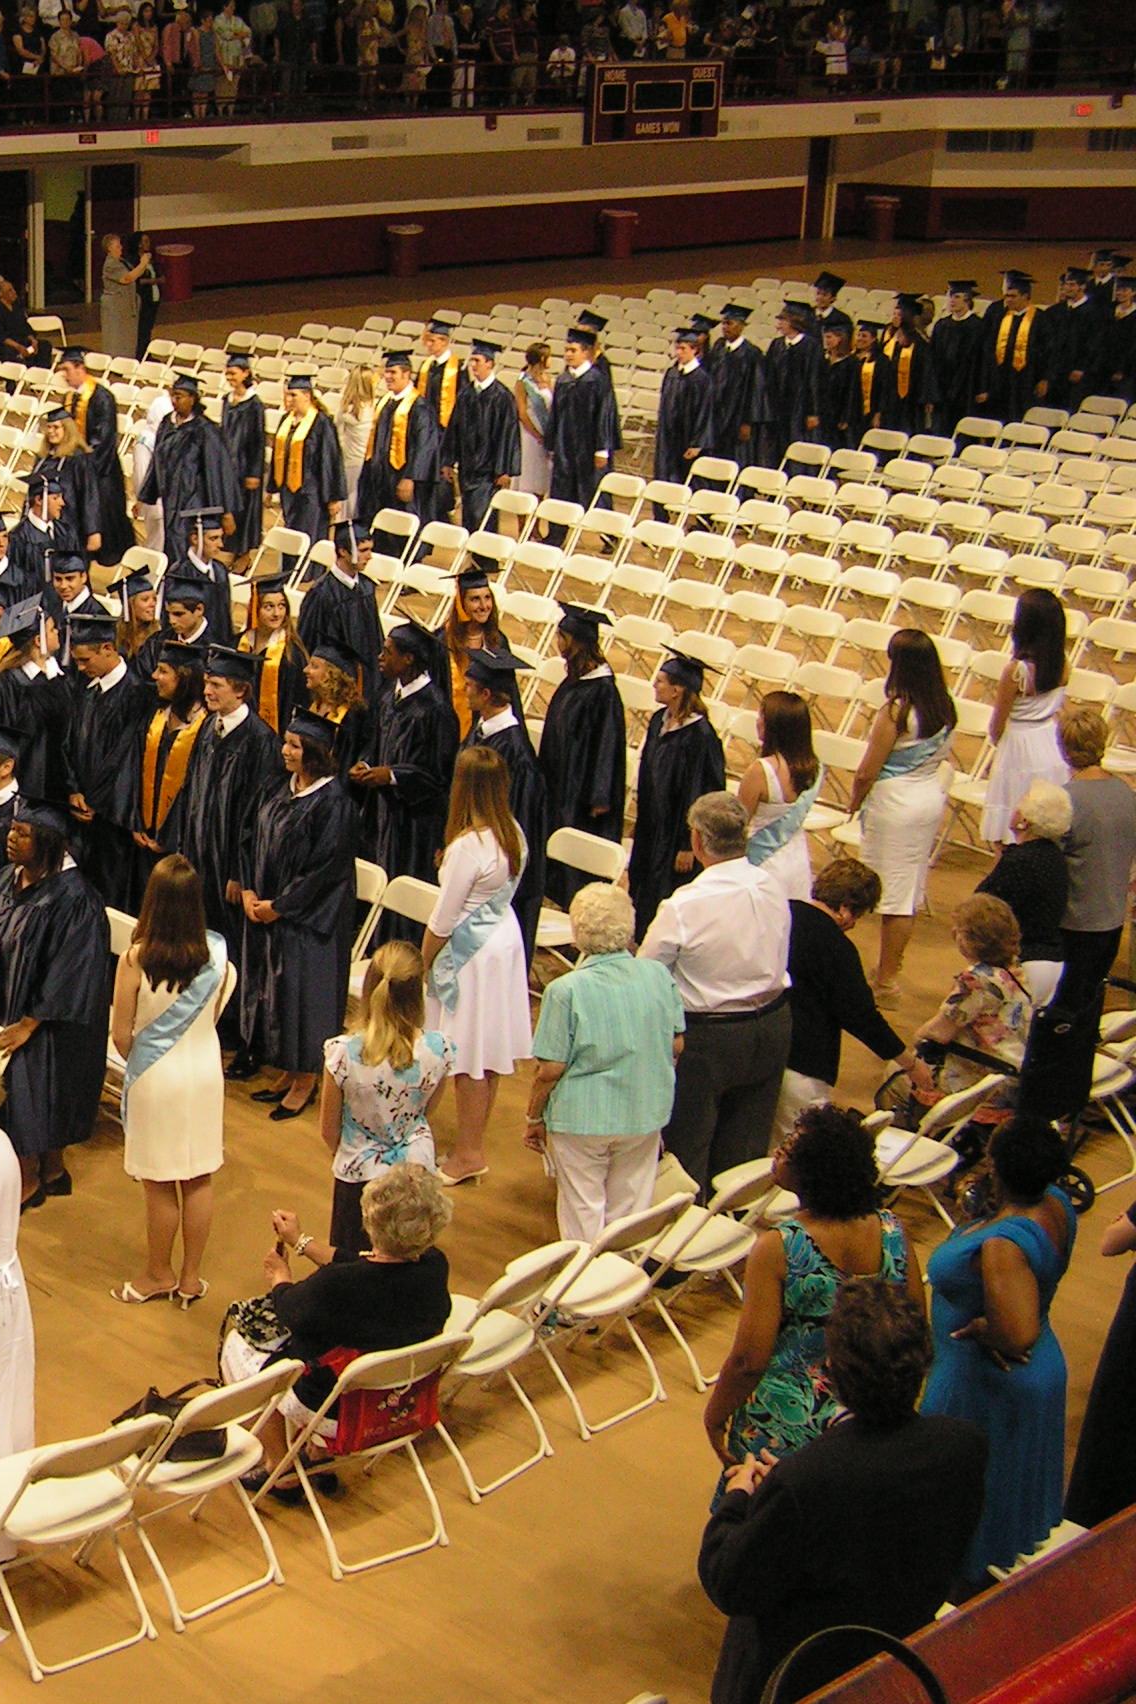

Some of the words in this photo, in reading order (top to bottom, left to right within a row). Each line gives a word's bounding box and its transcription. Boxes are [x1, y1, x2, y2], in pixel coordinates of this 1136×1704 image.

[605, 70, 627, 81] HOME
[693, 67, 716, 78] GUEST
[636, 123, 661, 134] GAMES
[663, 122, 679, 133] WON
